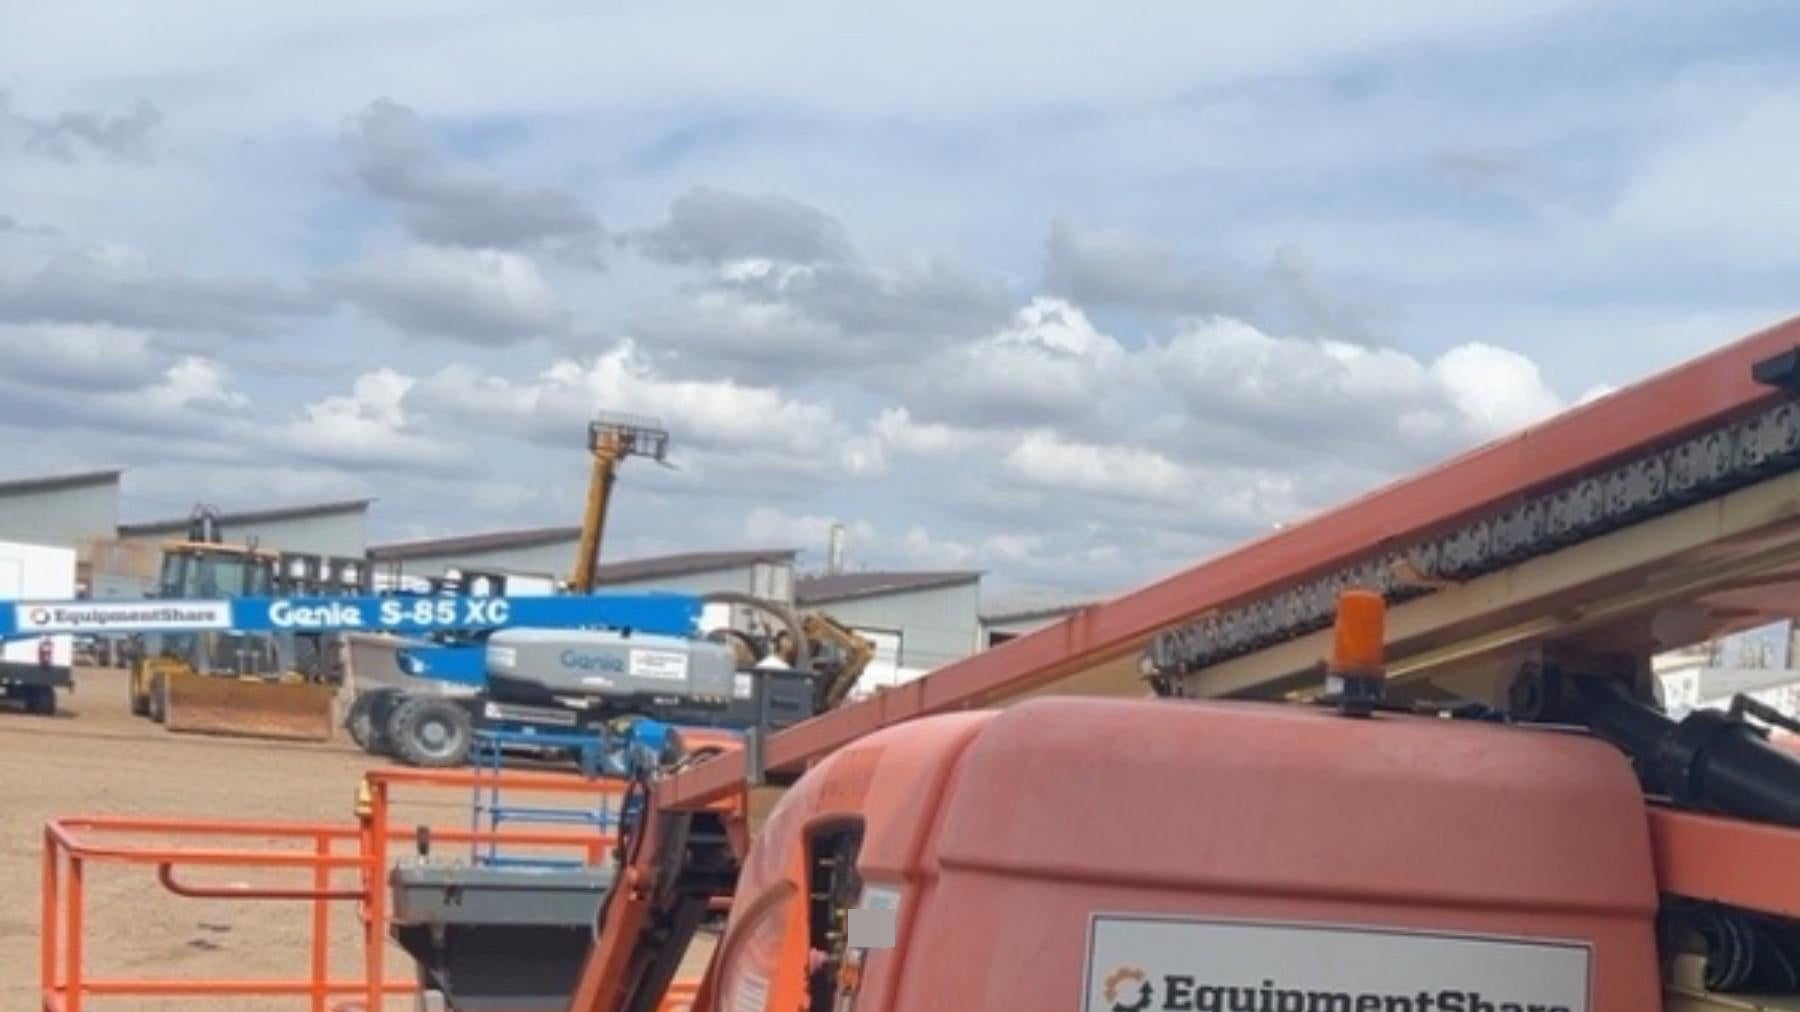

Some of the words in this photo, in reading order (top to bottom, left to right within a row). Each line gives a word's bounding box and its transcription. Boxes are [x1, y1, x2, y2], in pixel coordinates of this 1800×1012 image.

[54, 607, 217, 625] EquipmentShare
[268, 599, 364, 627] Genie
[379, 598, 457, 625] S-85
[463, 598, 509, 624] XC
[560, 651, 625, 673] Genie
